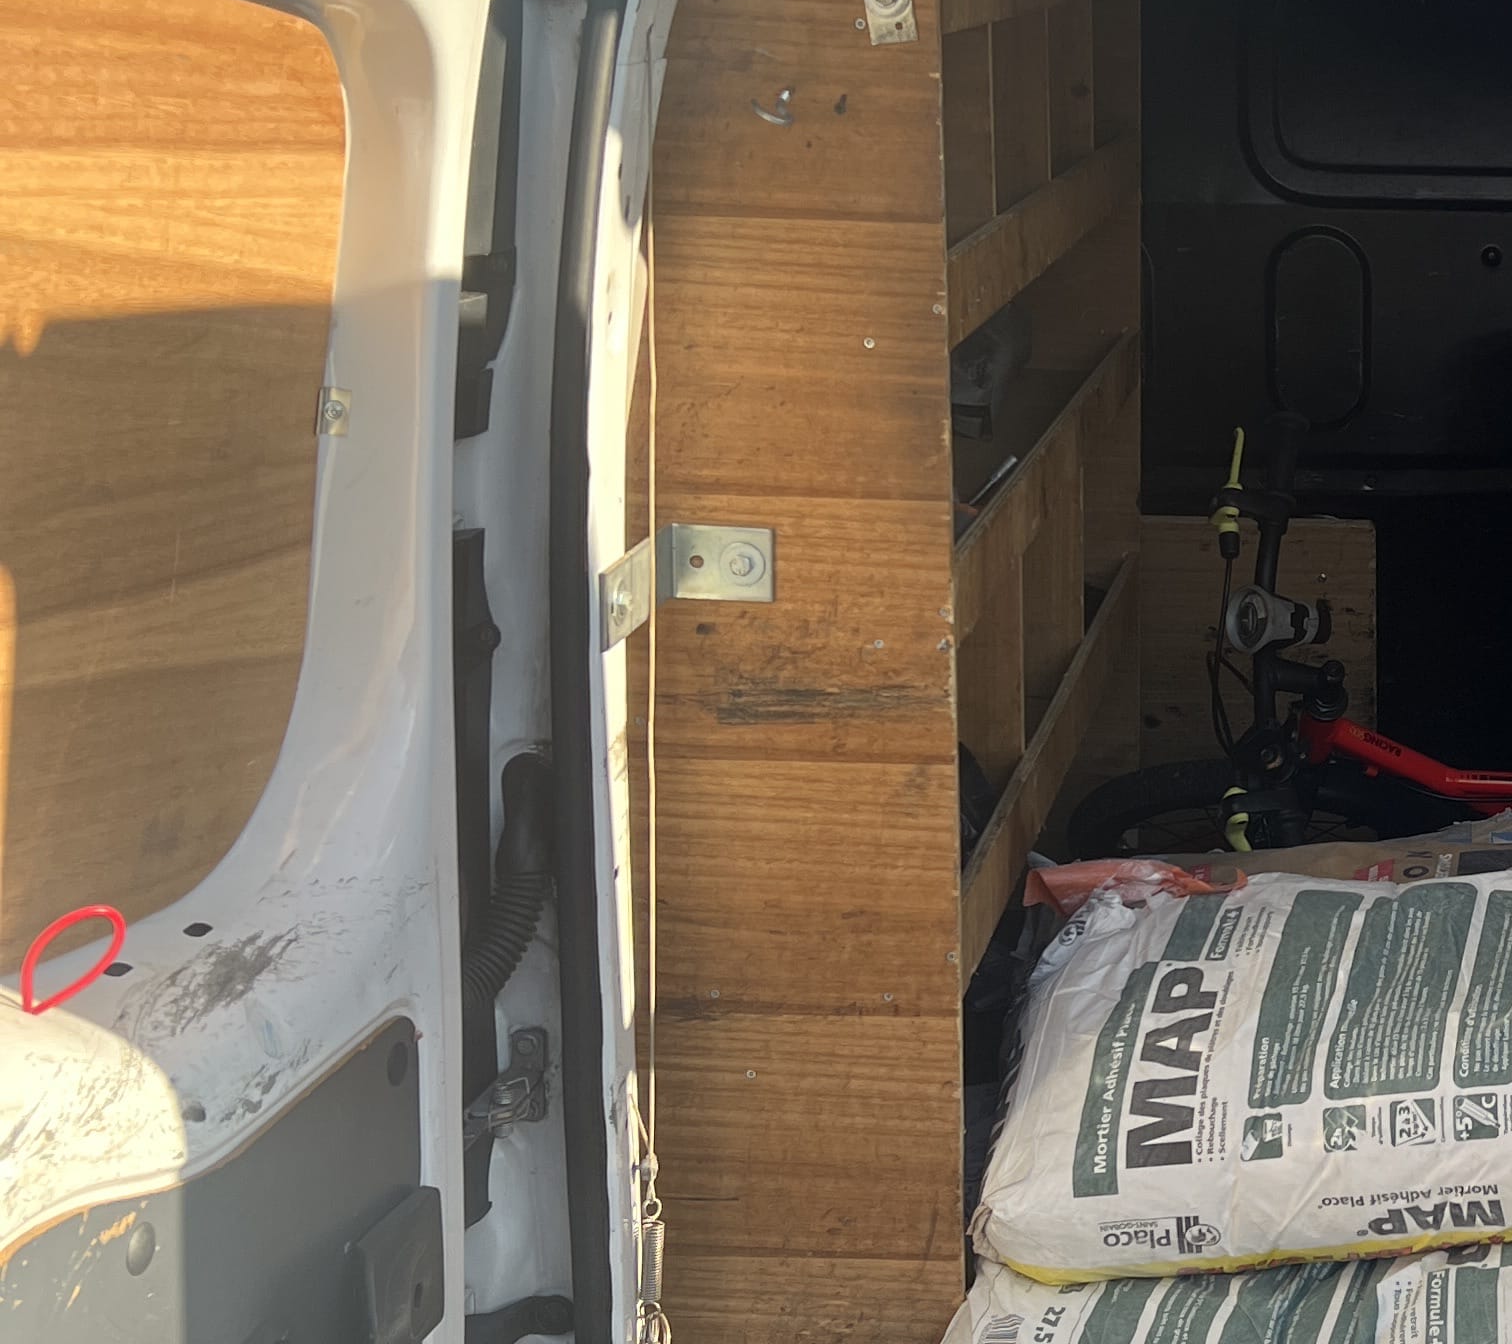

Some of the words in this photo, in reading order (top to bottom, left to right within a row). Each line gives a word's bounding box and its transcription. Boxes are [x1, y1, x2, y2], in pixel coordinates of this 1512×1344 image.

[1330, 1033, 1346, 1088] Application
[1094, 1107, 1113, 1174] Mortier
[1365, 1188, 1432, 1205] Adhésif
[1437, 1184, 1498, 1196] Mortier
[1104, 1229, 1171, 1249] Placo
[1034, 1306, 1066, 1344] 27,5
